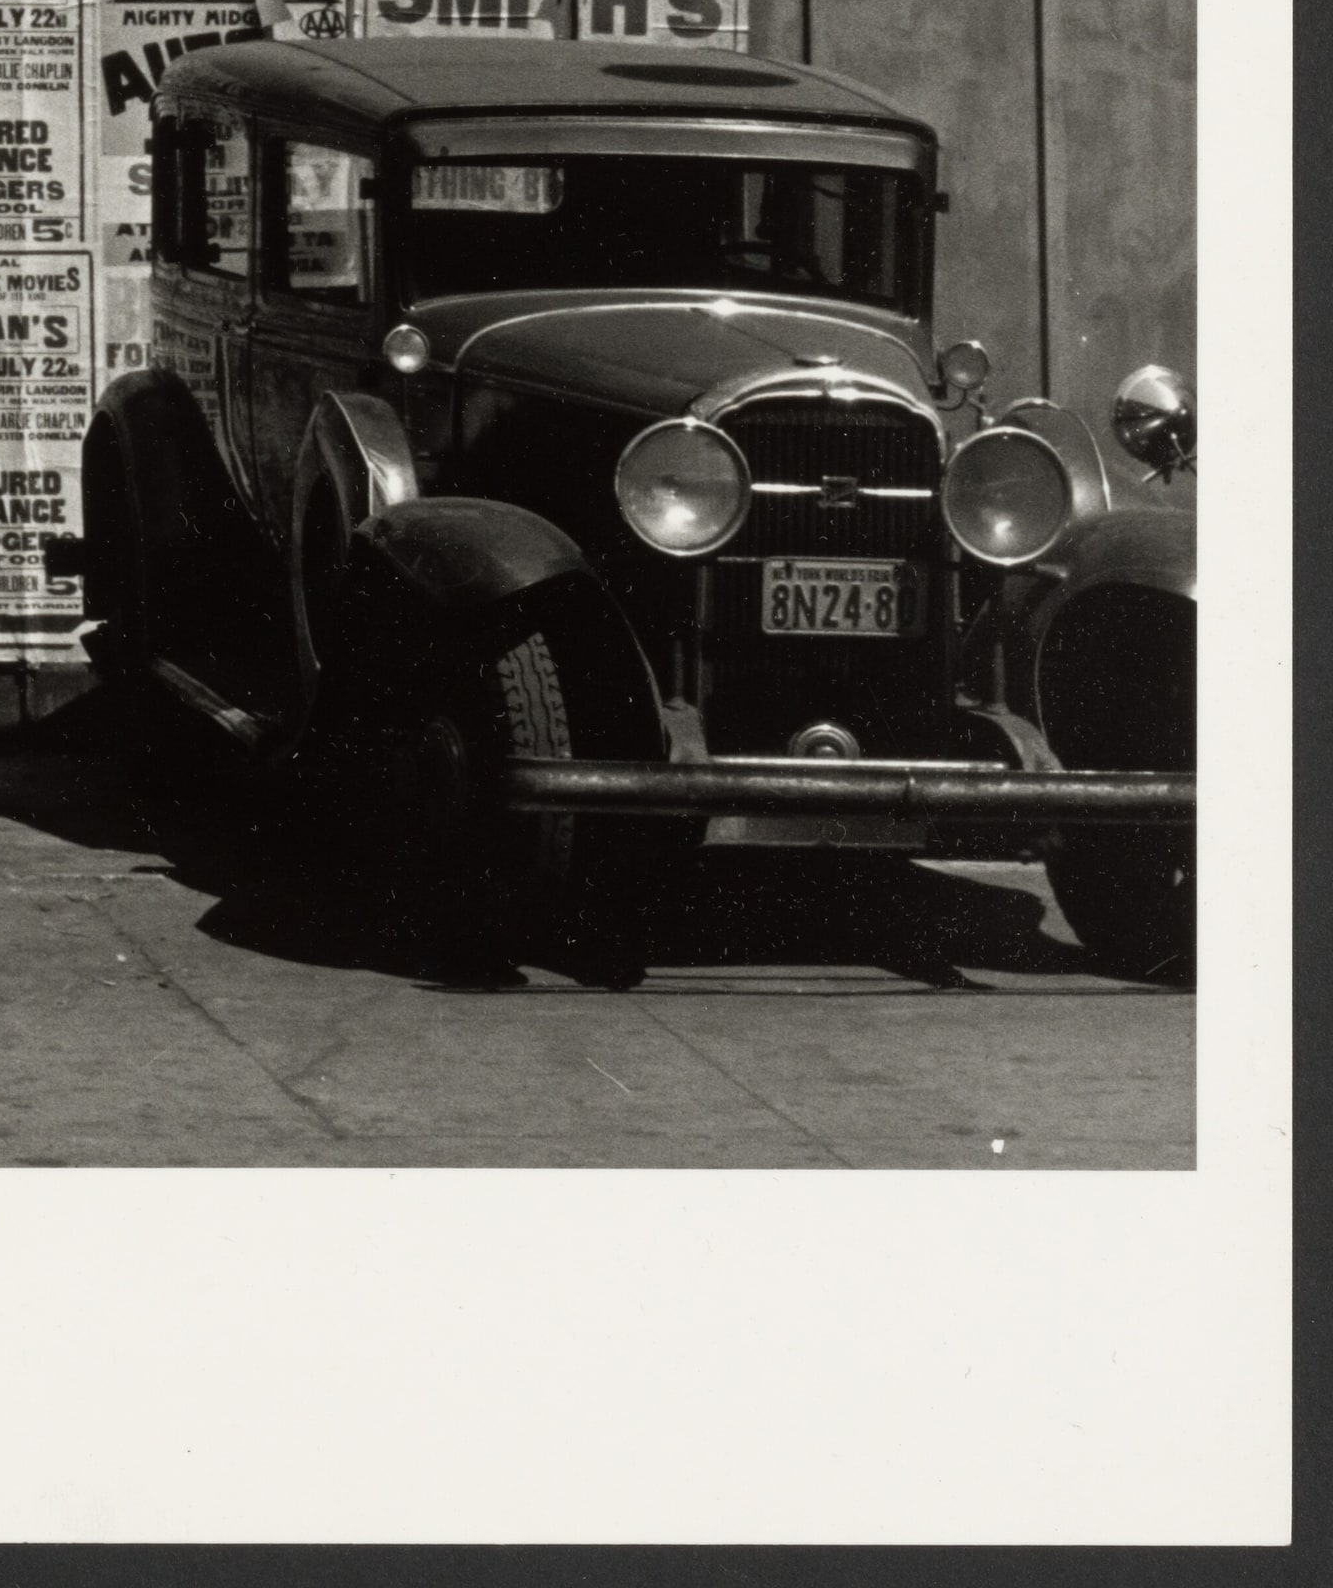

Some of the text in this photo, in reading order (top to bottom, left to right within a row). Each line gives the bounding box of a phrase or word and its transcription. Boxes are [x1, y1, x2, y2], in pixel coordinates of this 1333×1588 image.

[122, 9, 262, 26] MIGHTY MIDG
[14, 35, 75, 46] LANGDON
[24, 62, 73, 80] CHAPLIN
[6, 267, 81, 292] MOVIES
[26, 385, 87, 395] LANGDON
[35, 412, 86, 430] CHAPLIN
